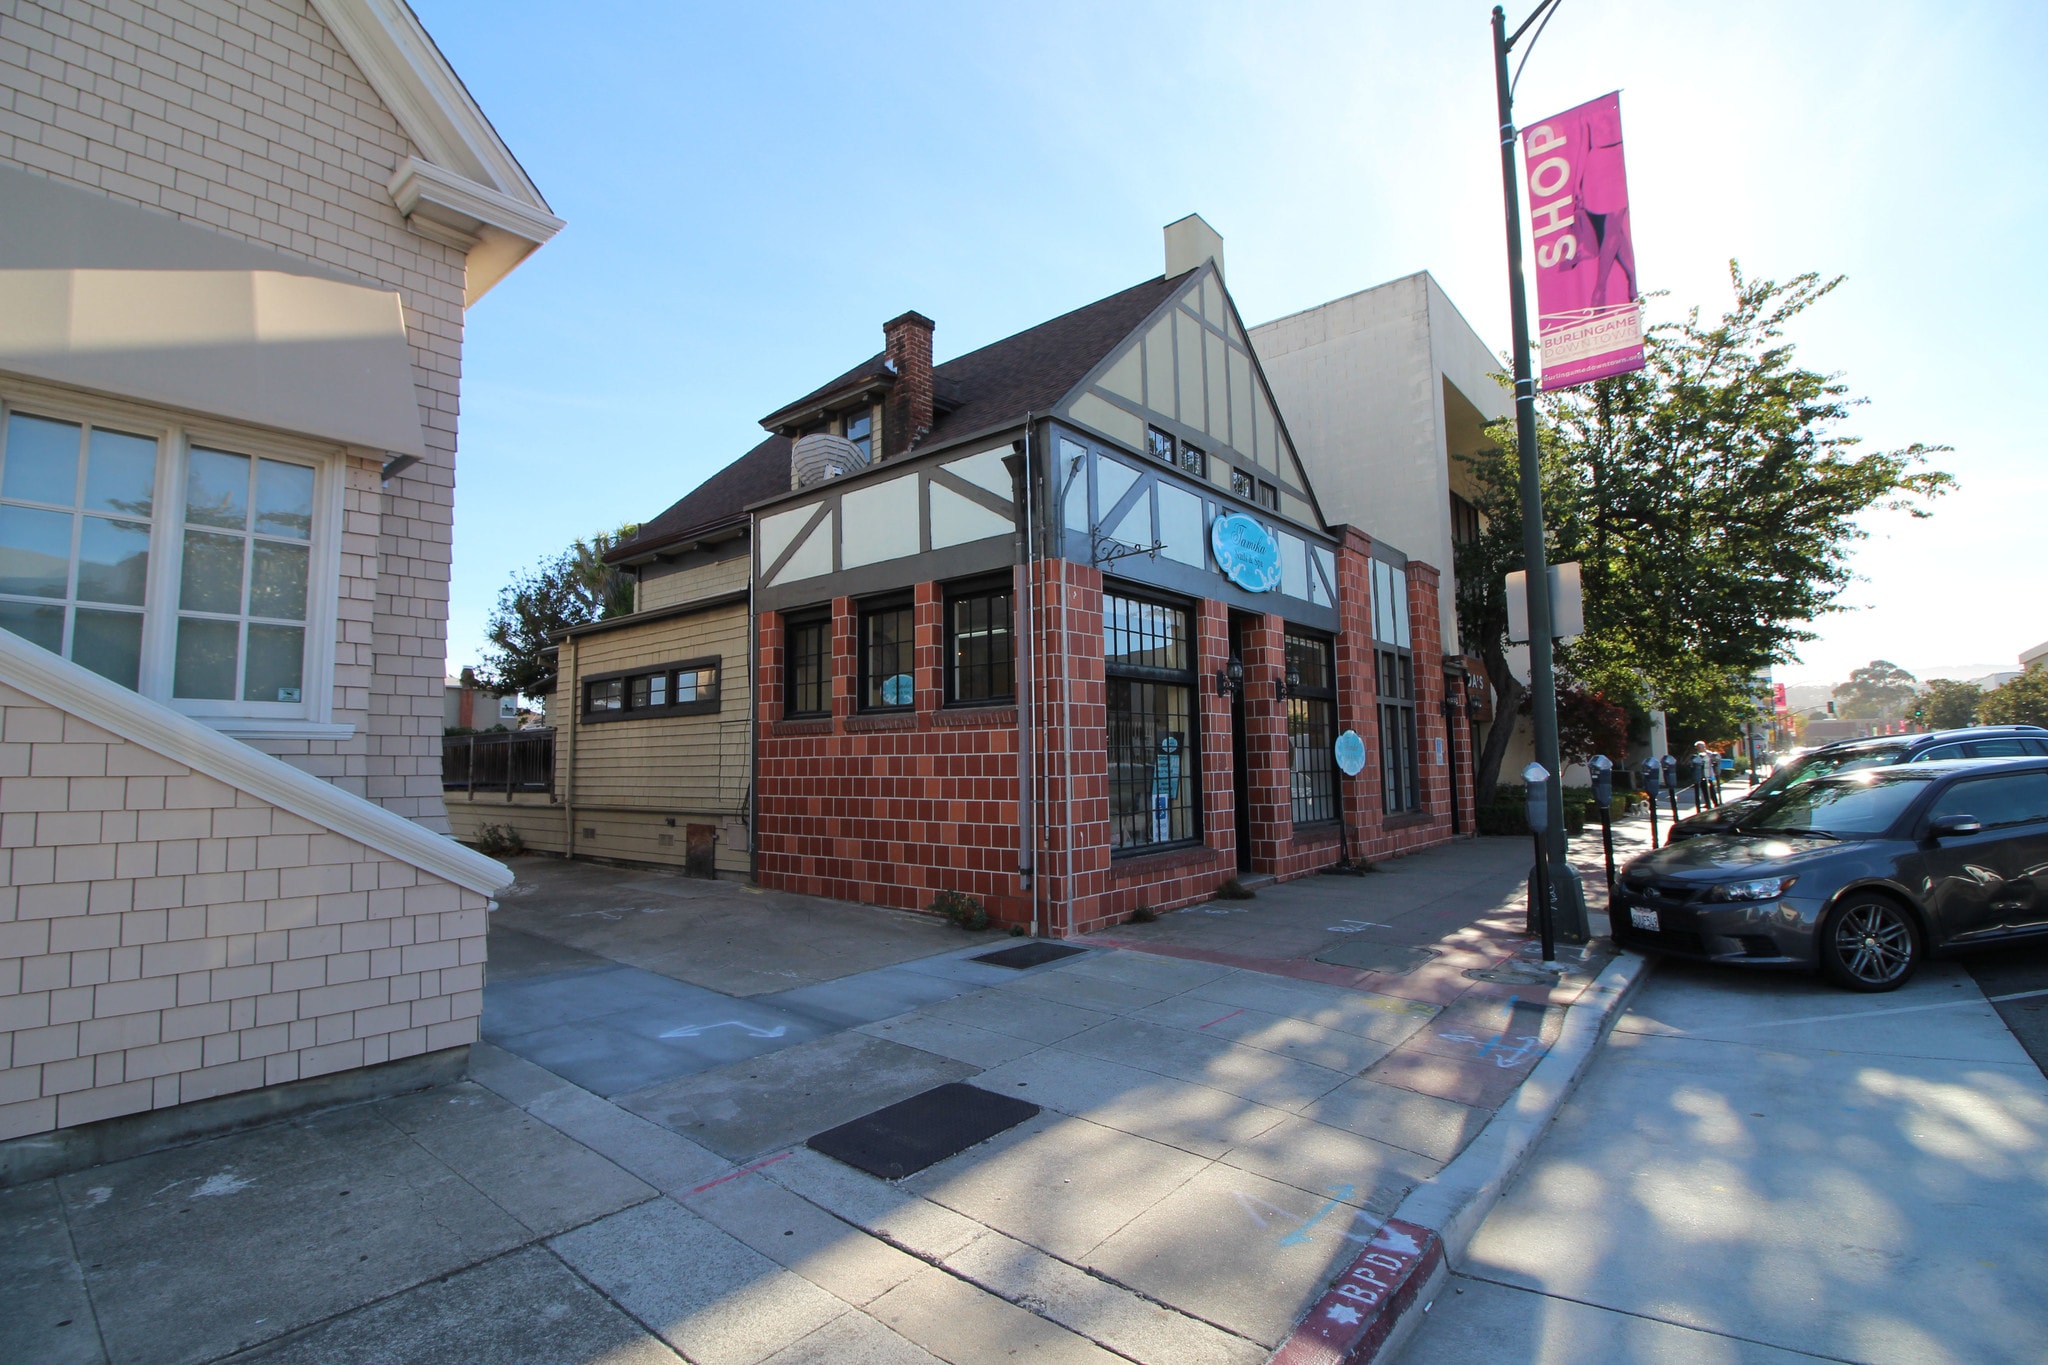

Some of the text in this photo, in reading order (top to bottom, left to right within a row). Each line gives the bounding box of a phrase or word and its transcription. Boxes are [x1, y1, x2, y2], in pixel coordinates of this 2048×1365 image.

[1527, 124, 1577, 268] SHOP
[1543, 315, 1637, 349] BURLINGAME
[1544, 325, 1639, 358] DOWNTOWN
